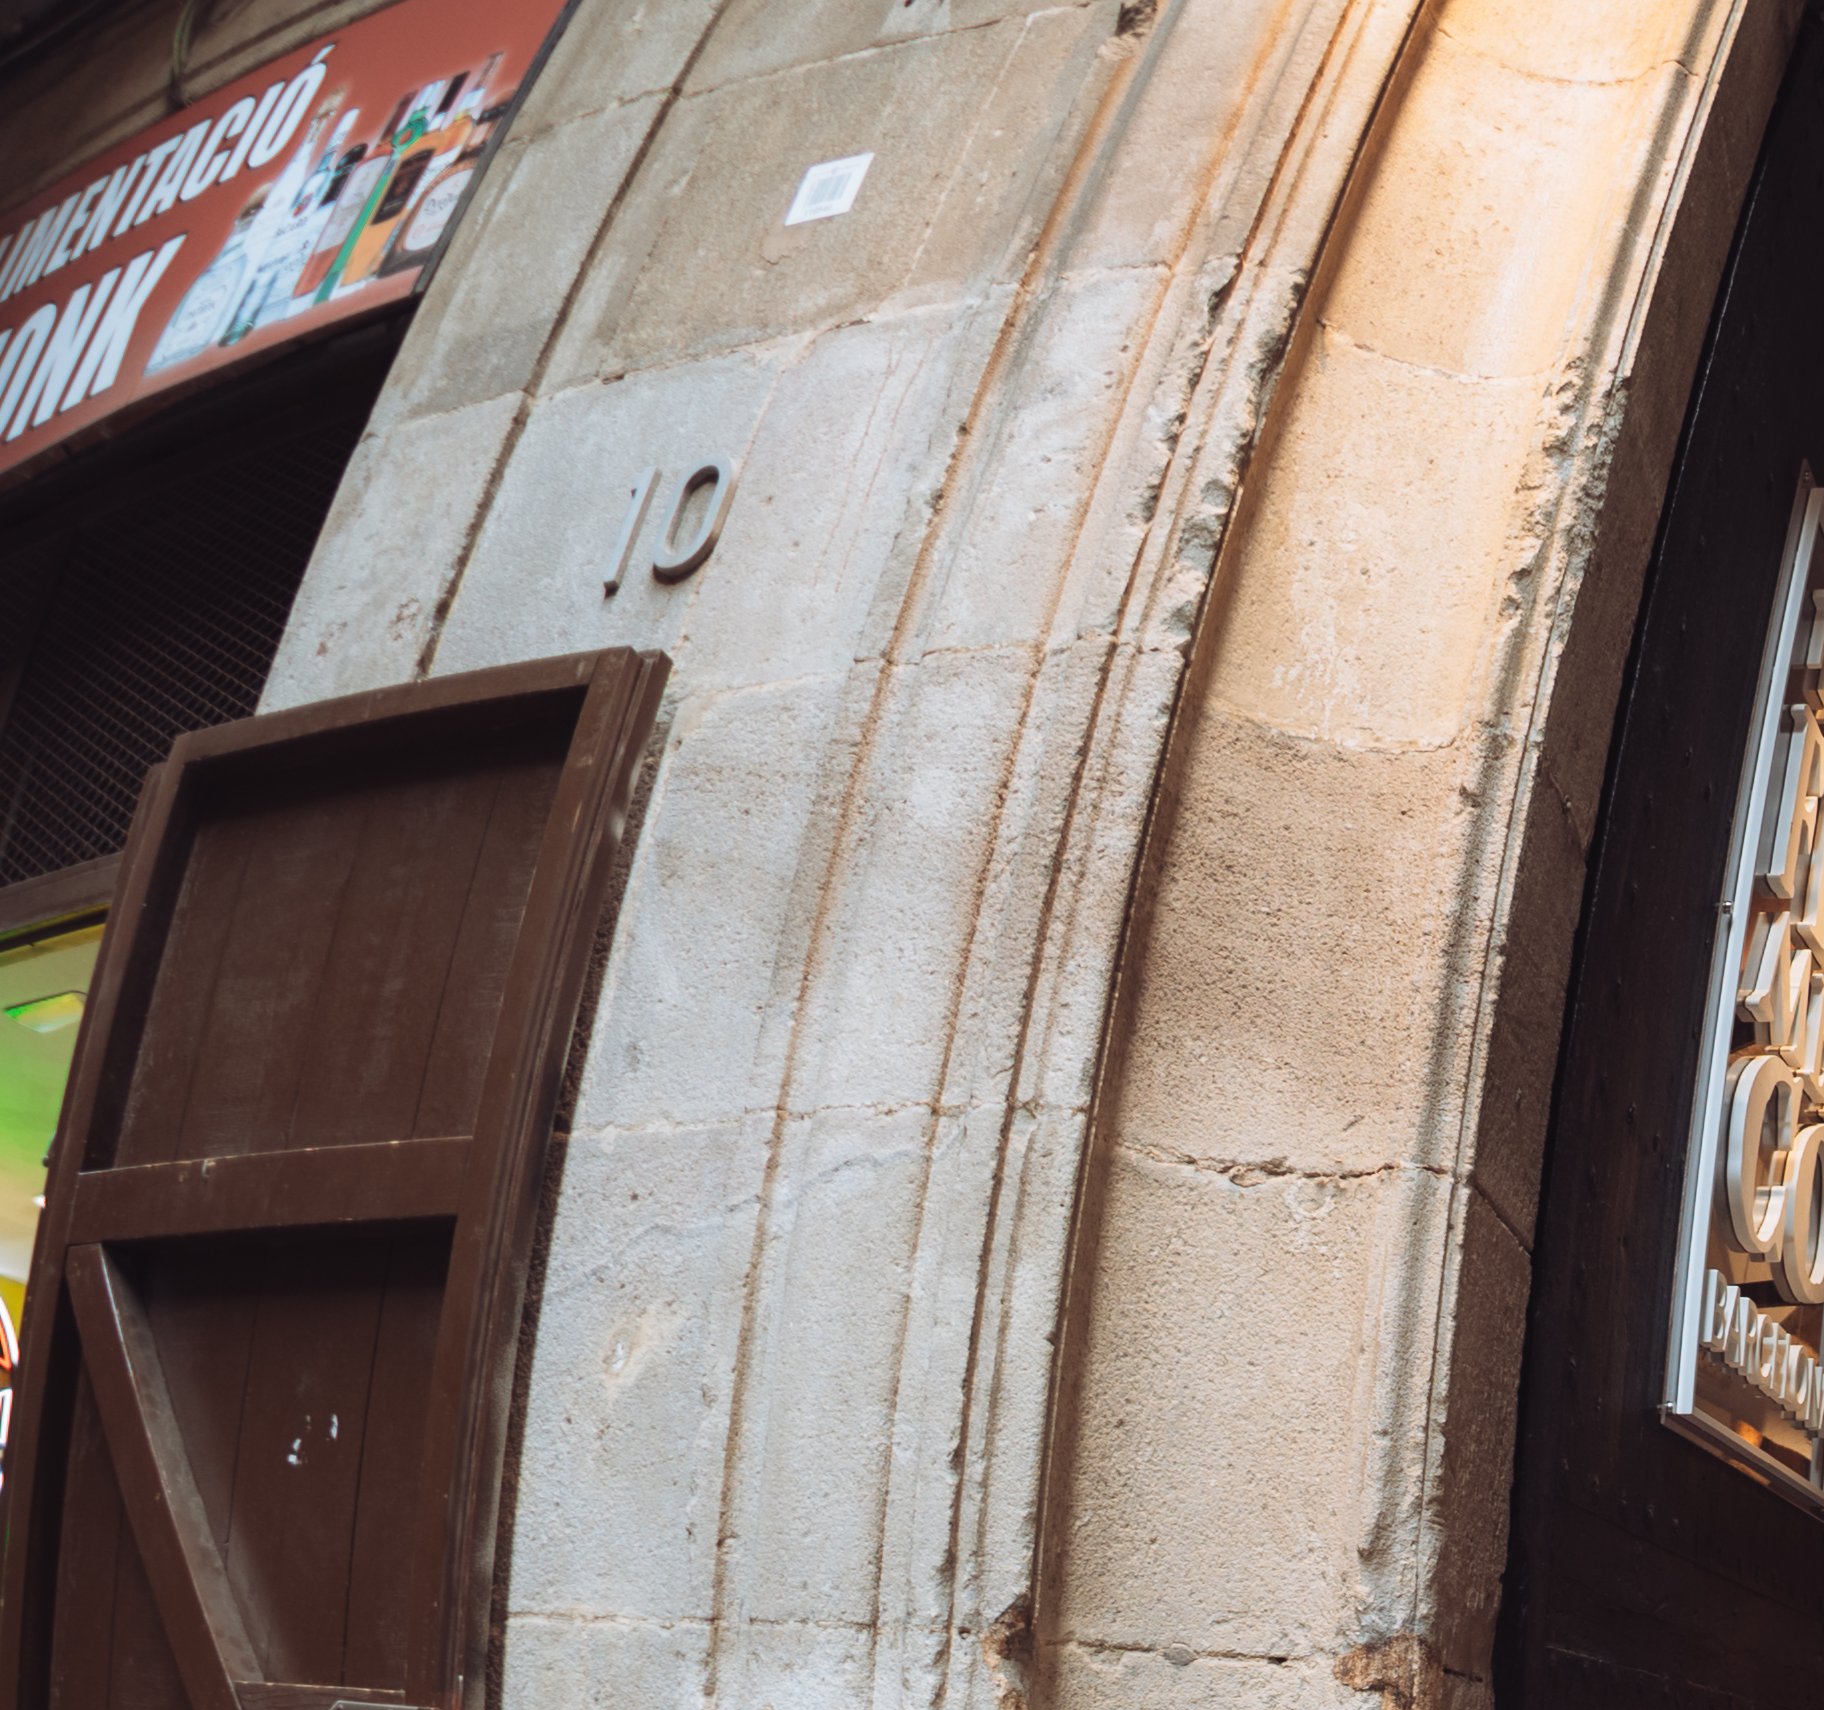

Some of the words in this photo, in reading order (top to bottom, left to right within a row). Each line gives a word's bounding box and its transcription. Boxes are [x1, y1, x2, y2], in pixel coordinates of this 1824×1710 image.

[0, 43, 336, 302] IMENTACIÓ
[0, 233, 188, 442] ONK
[603, 454, 737, 595] 10
